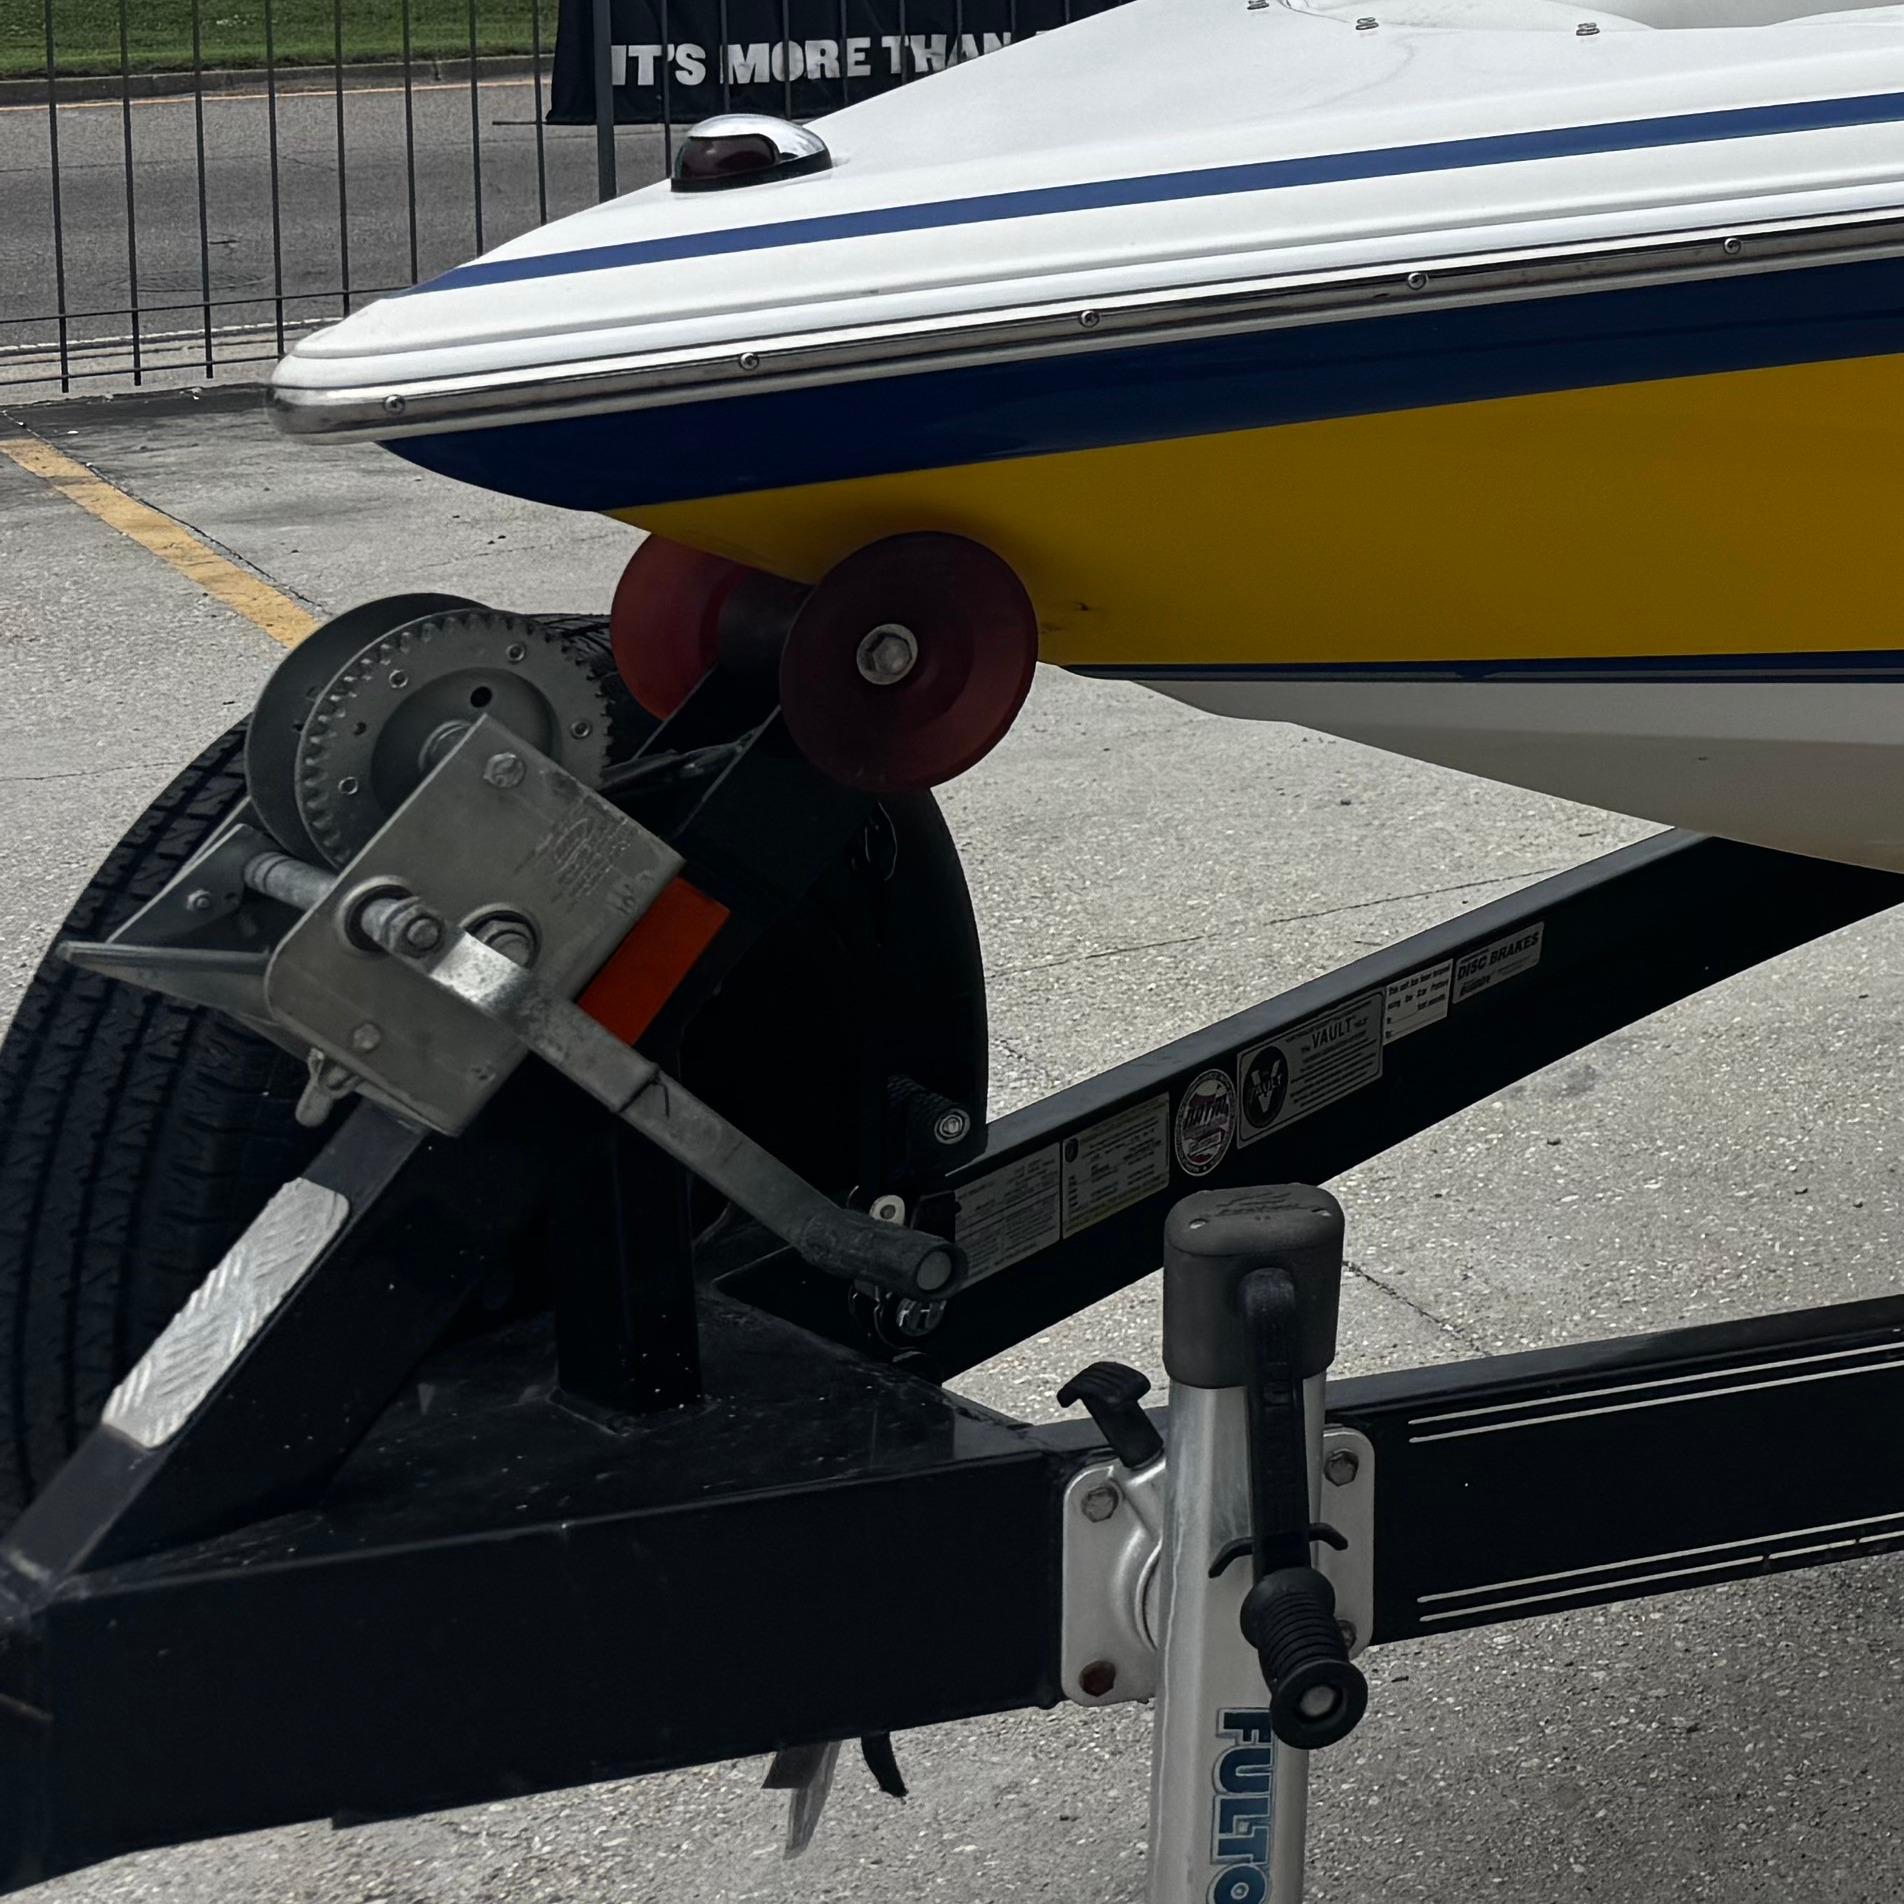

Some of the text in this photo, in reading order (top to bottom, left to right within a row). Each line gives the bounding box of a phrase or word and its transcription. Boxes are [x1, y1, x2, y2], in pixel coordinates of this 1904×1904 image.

[611, 44, 706, 86] IT'S
[720, 37, 871, 85] MORE
[1458, 955, 1488, 981] DISC
[1489, 932, 1538, 965] BRAKES
[1311, 1018, 1354, 1049] VAULT
